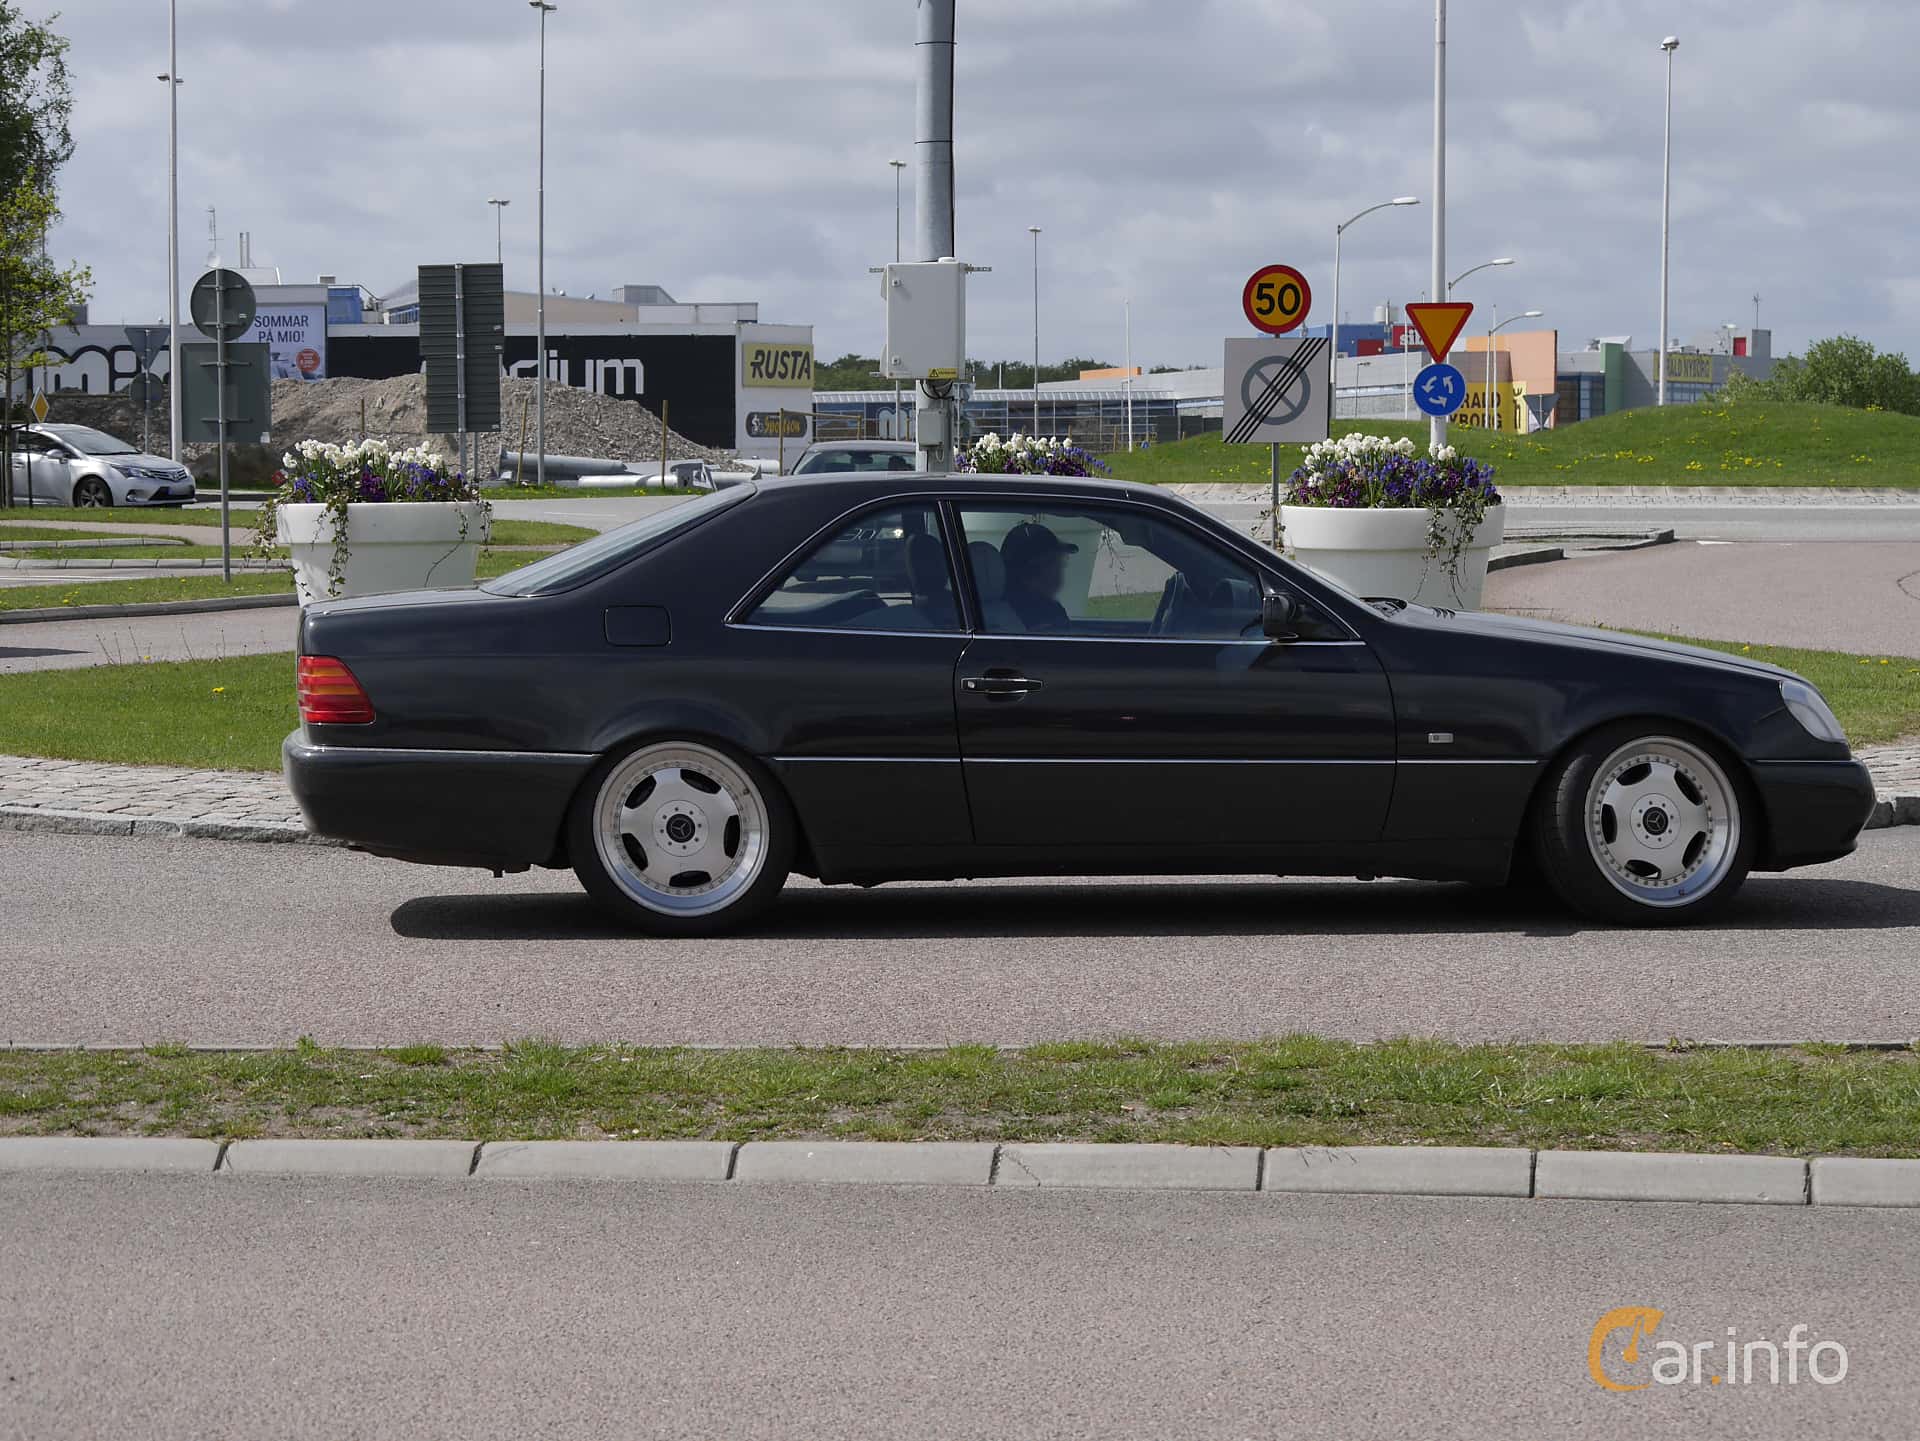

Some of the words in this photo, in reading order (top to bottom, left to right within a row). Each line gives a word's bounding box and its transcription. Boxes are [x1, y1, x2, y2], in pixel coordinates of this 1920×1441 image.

[1256, 283, 1301, 315] 50
[254, 315, 309, 328] SOMMAR
[277, 331, 305, 343] MIO!
[750, 349, 811, 380] RUSTA
[1461, 392, 1501, 409] RALD
[1450, 413, 1502, 430] YBORG
